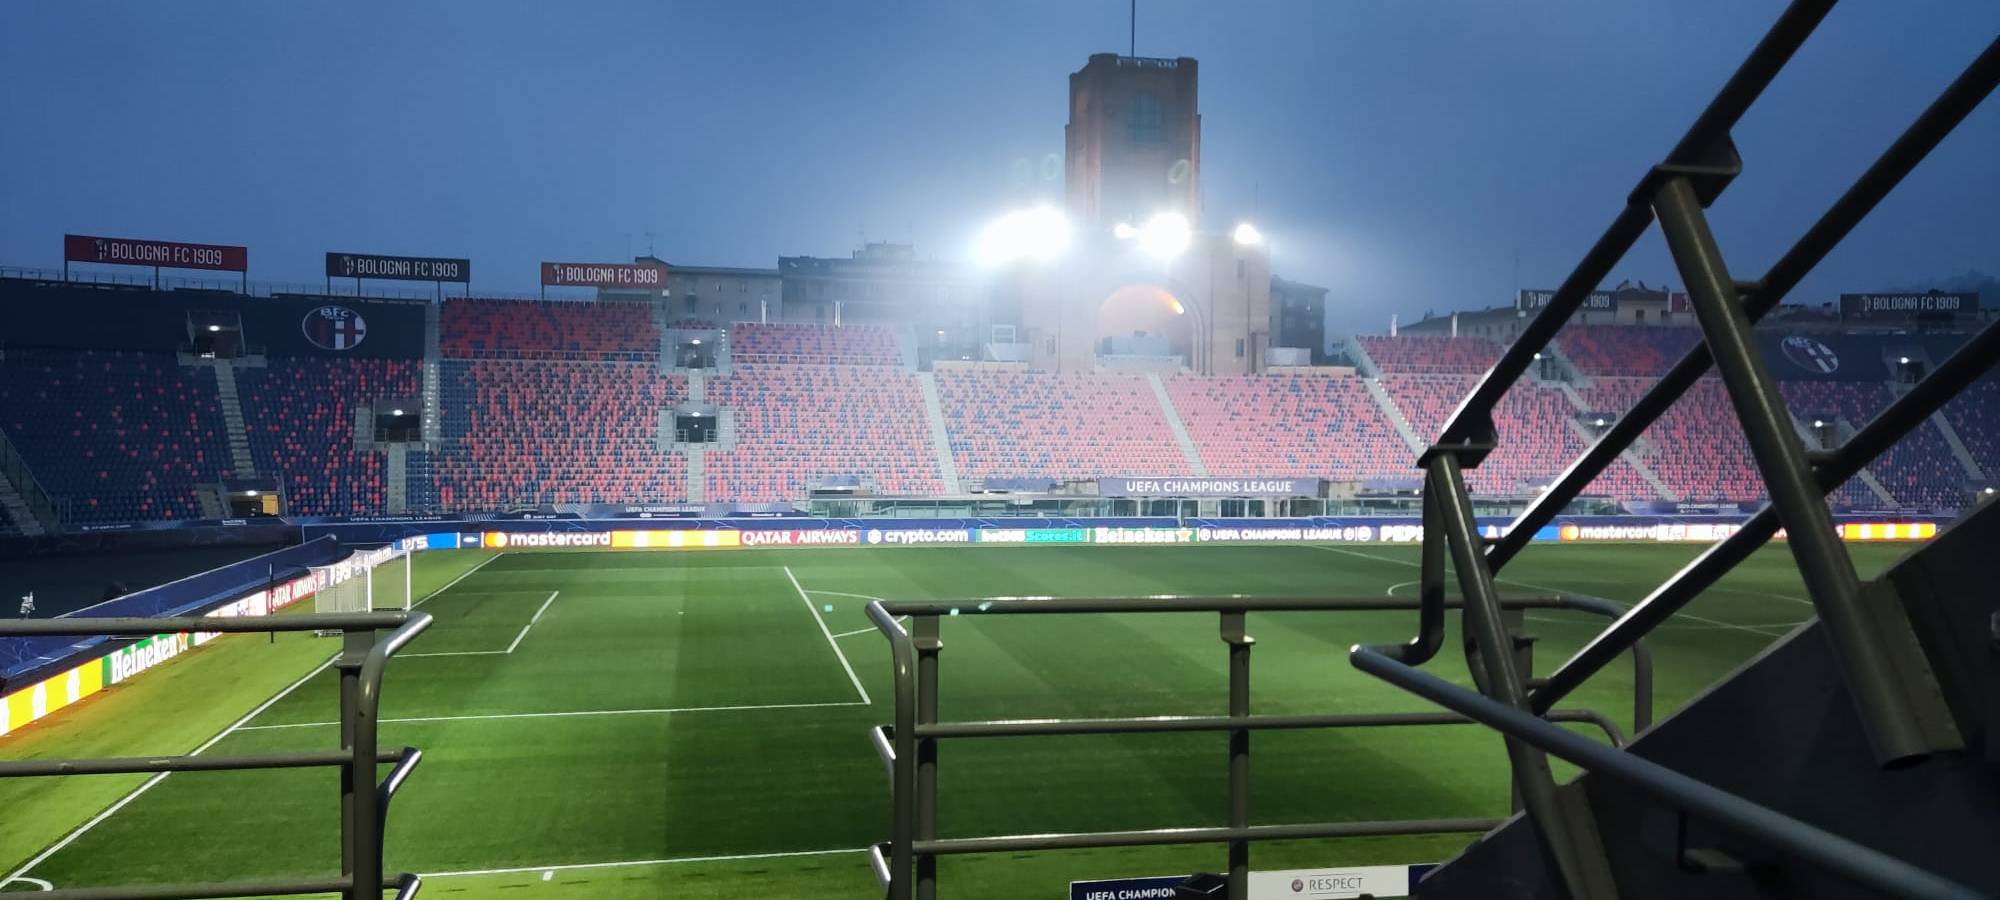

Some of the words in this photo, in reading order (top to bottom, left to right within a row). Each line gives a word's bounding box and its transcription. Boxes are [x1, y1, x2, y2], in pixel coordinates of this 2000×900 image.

[111, 242, 169, 262] BOLOGNA
[174, 248, 190, 263] FC
[192, 249, 222, 265] 1909
[357, 258, 410, 275] BOLOGNA
[415, 262, 429, 277] FC
[432, 262, 458, 278] 1909
[566, 266, 614, 282] BOLOGNA
[618, 268, 631, 283] FC
[633, 268, 658, 284] 1909
[1590, 294, 1610, 308] 1909
[1873, 296, 1918, 311] BOLOGNA
[1920, 296, 1934, 311] FC
[1935, 296, 1960, 311] 1909
[1126, 480, 1160, 493] UEFA
[1163, 480, 1240, 493] CHAMPIONS
[1243, 480, 1293, 493] LEAGUE
[510, 531, 611, 547] mastercard
[742, 531, 792, 546] QATAR
[796, 531, 857, 545] AIRWAYS
[884, 528, 969, 544] crypto.com
[1094, 527, 1176, 543] Heineken
[1212, 528, 1240, 541] UEFA
[1241, 528, 1301, 541] CHAMPIONS
[1303, 528, 1342, 541] LEAGUE
[1580, 525, 1658, 540] mastercard
[291, 574, 317, 601] AIRWAYS
[111, 633, 178, 685] Heineken
[1309, 877, 1363, 891] RESPECT
